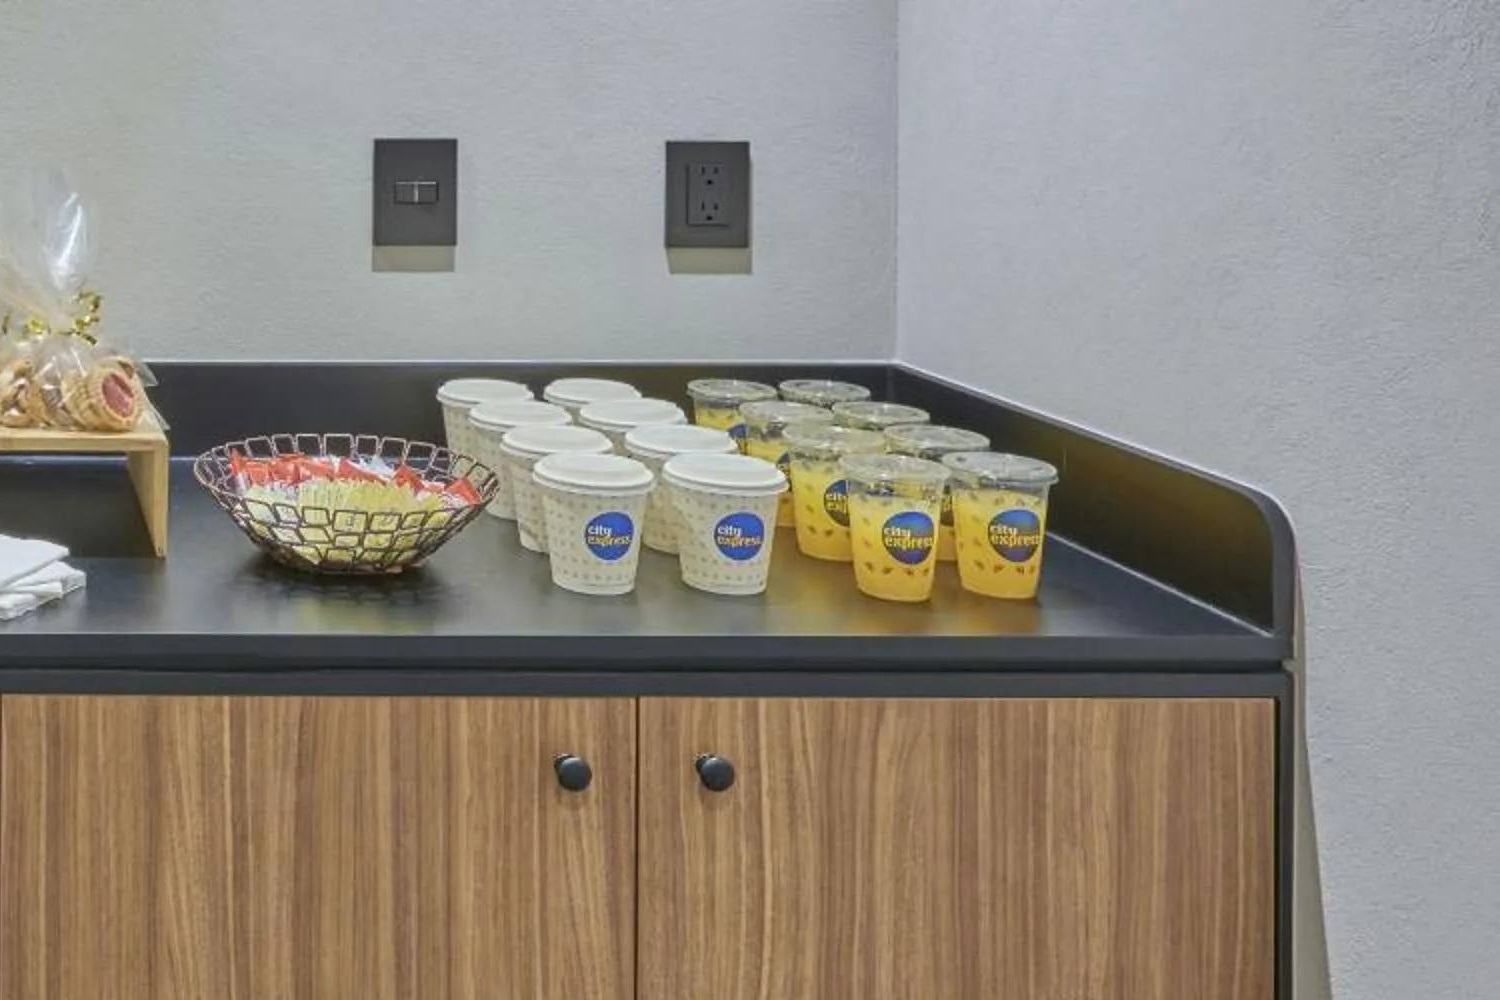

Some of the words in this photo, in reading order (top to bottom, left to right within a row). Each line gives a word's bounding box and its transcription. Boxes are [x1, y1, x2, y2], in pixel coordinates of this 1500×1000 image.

[588, 524, 612, 537] city
[717, 525, 742, 537] city
[883, 526, 911, 539] city
[990, 524, 1017, 537] city
